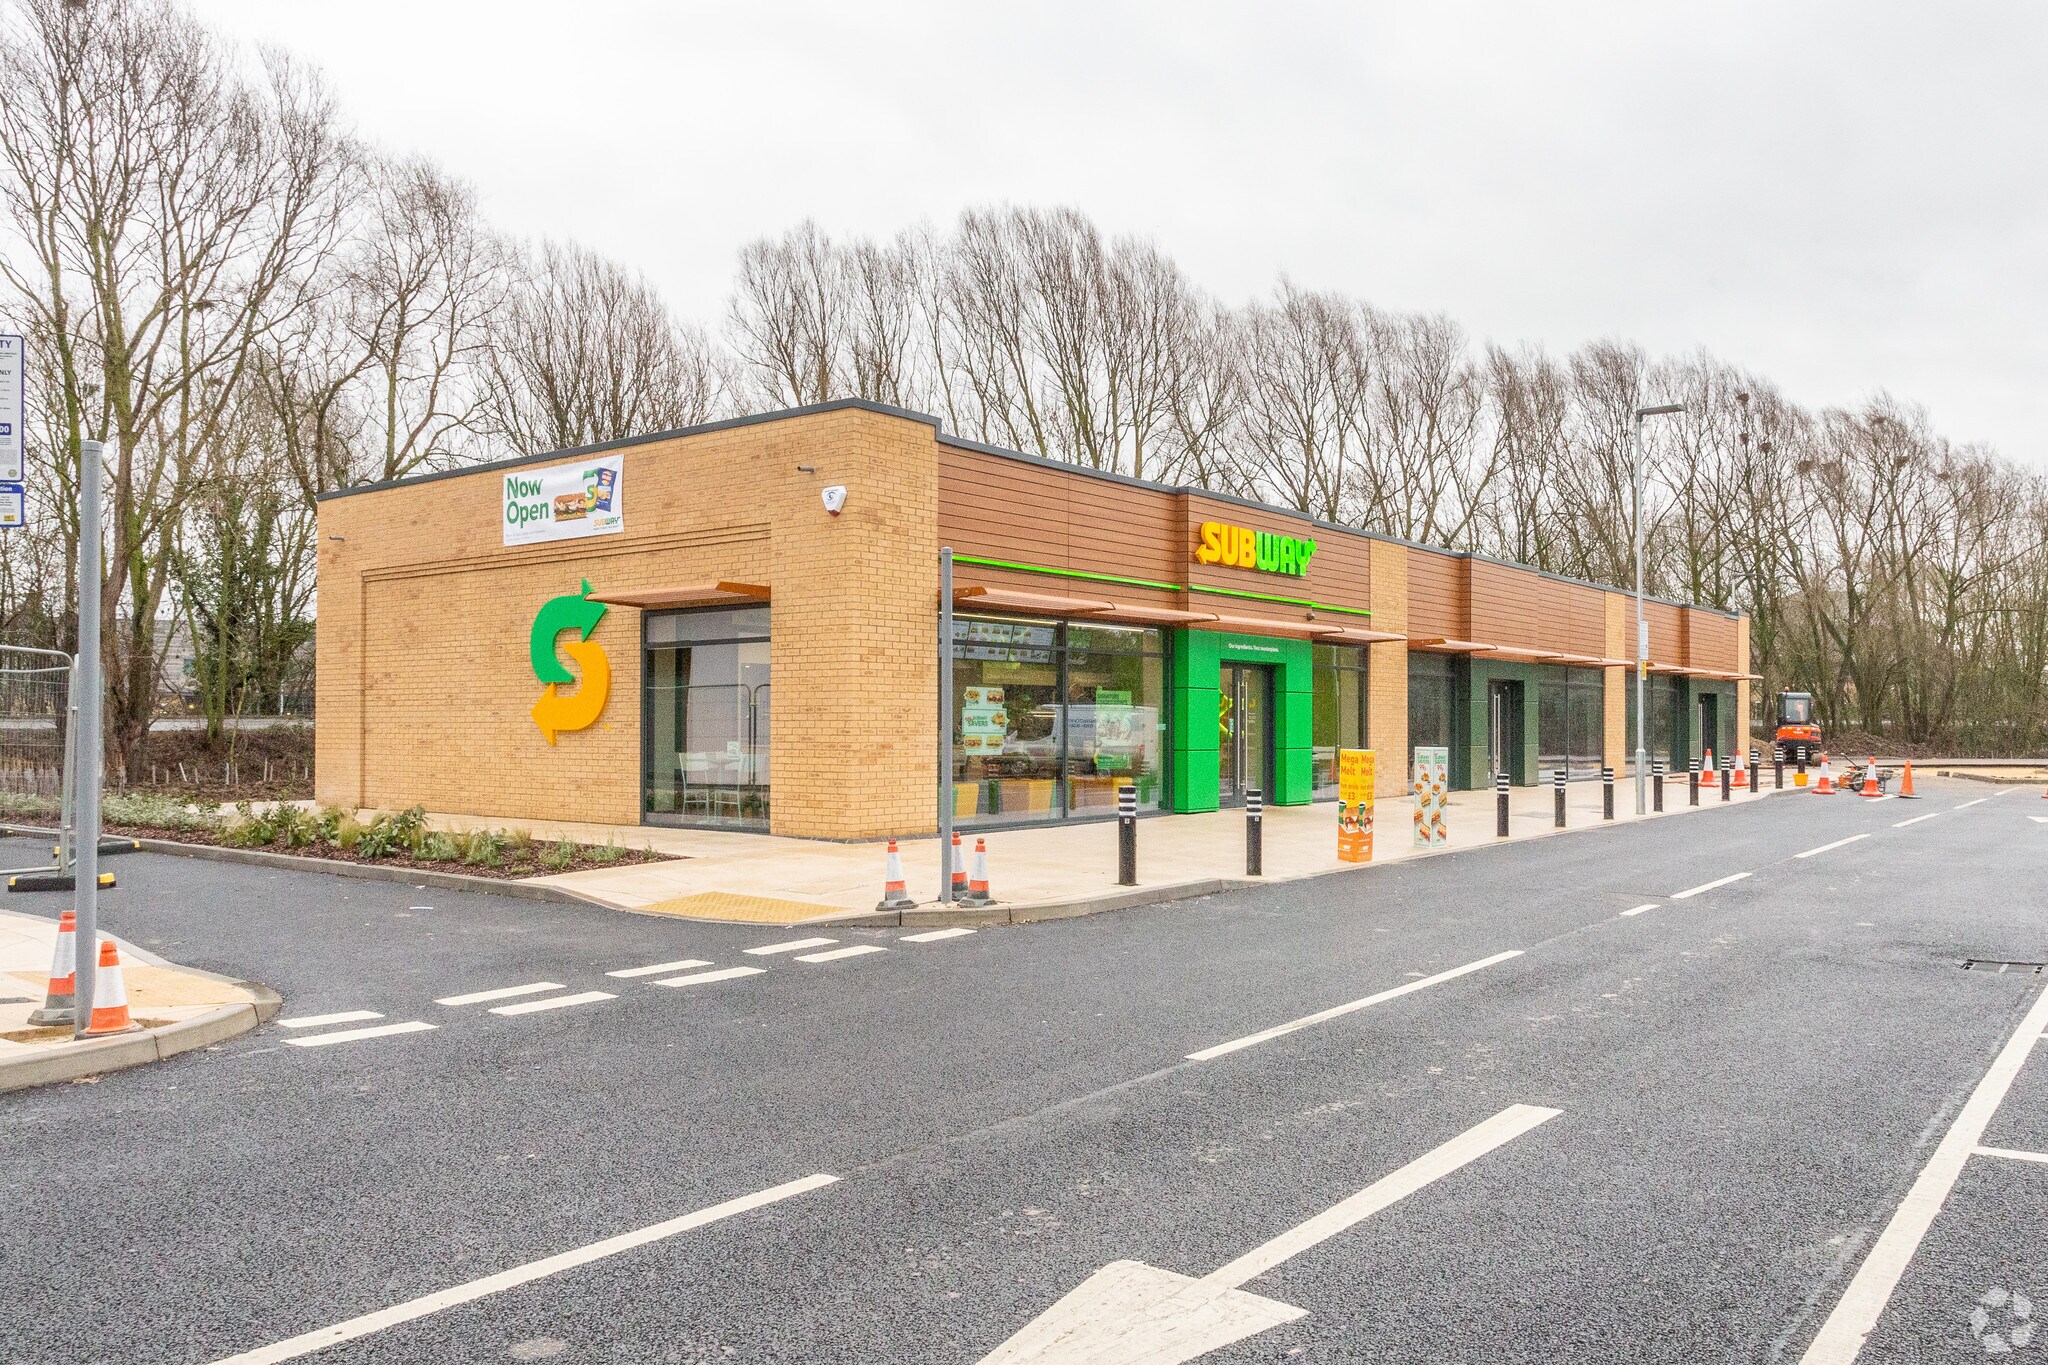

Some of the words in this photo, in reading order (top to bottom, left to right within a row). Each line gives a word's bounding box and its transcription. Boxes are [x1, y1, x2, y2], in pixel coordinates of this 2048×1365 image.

[507, 477, 543, 499] Now
[507, 501, 549, 528] Open
[594, 517, 621, 527] SUBWAY
[1195, 521, 1317, 577] SUBWAY
[1341, 754, 1359, 765] Mega
[1341, 766, 1355, 775] Melt
